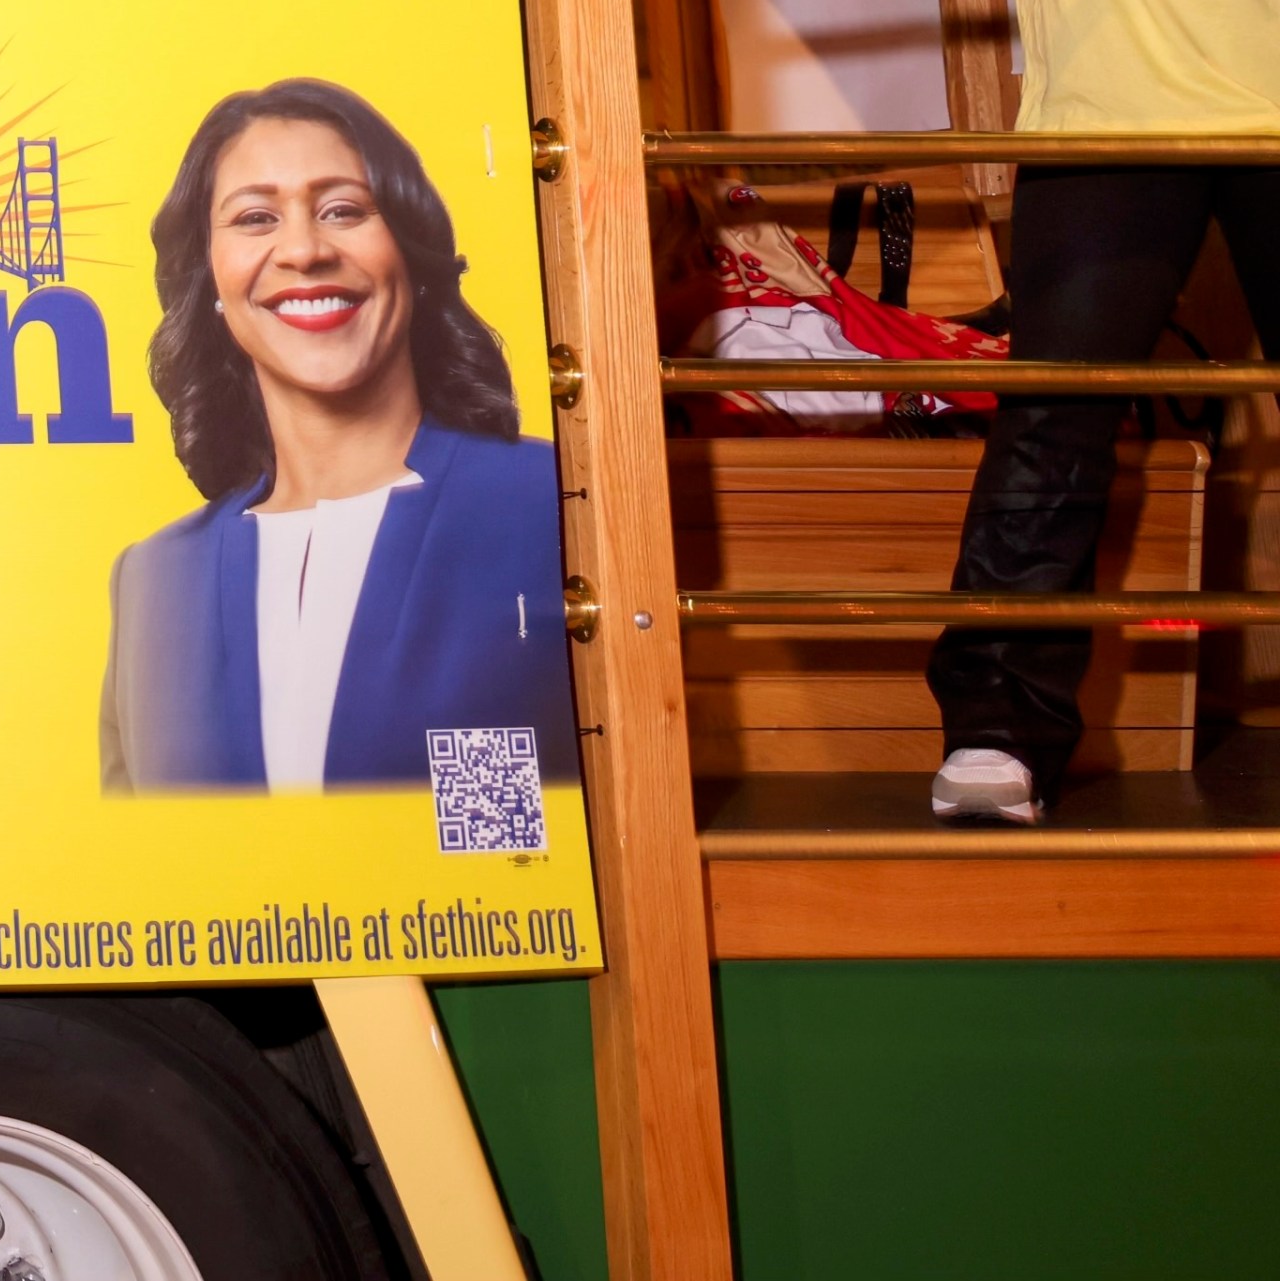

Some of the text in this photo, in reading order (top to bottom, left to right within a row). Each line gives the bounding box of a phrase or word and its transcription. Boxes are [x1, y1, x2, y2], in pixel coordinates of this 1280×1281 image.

[145, 920, 196, 968] are
[207, 902, 353, 966] available
[362, 909, 392, 963] at
[401, 897, 587, 967] sfethics.org.
